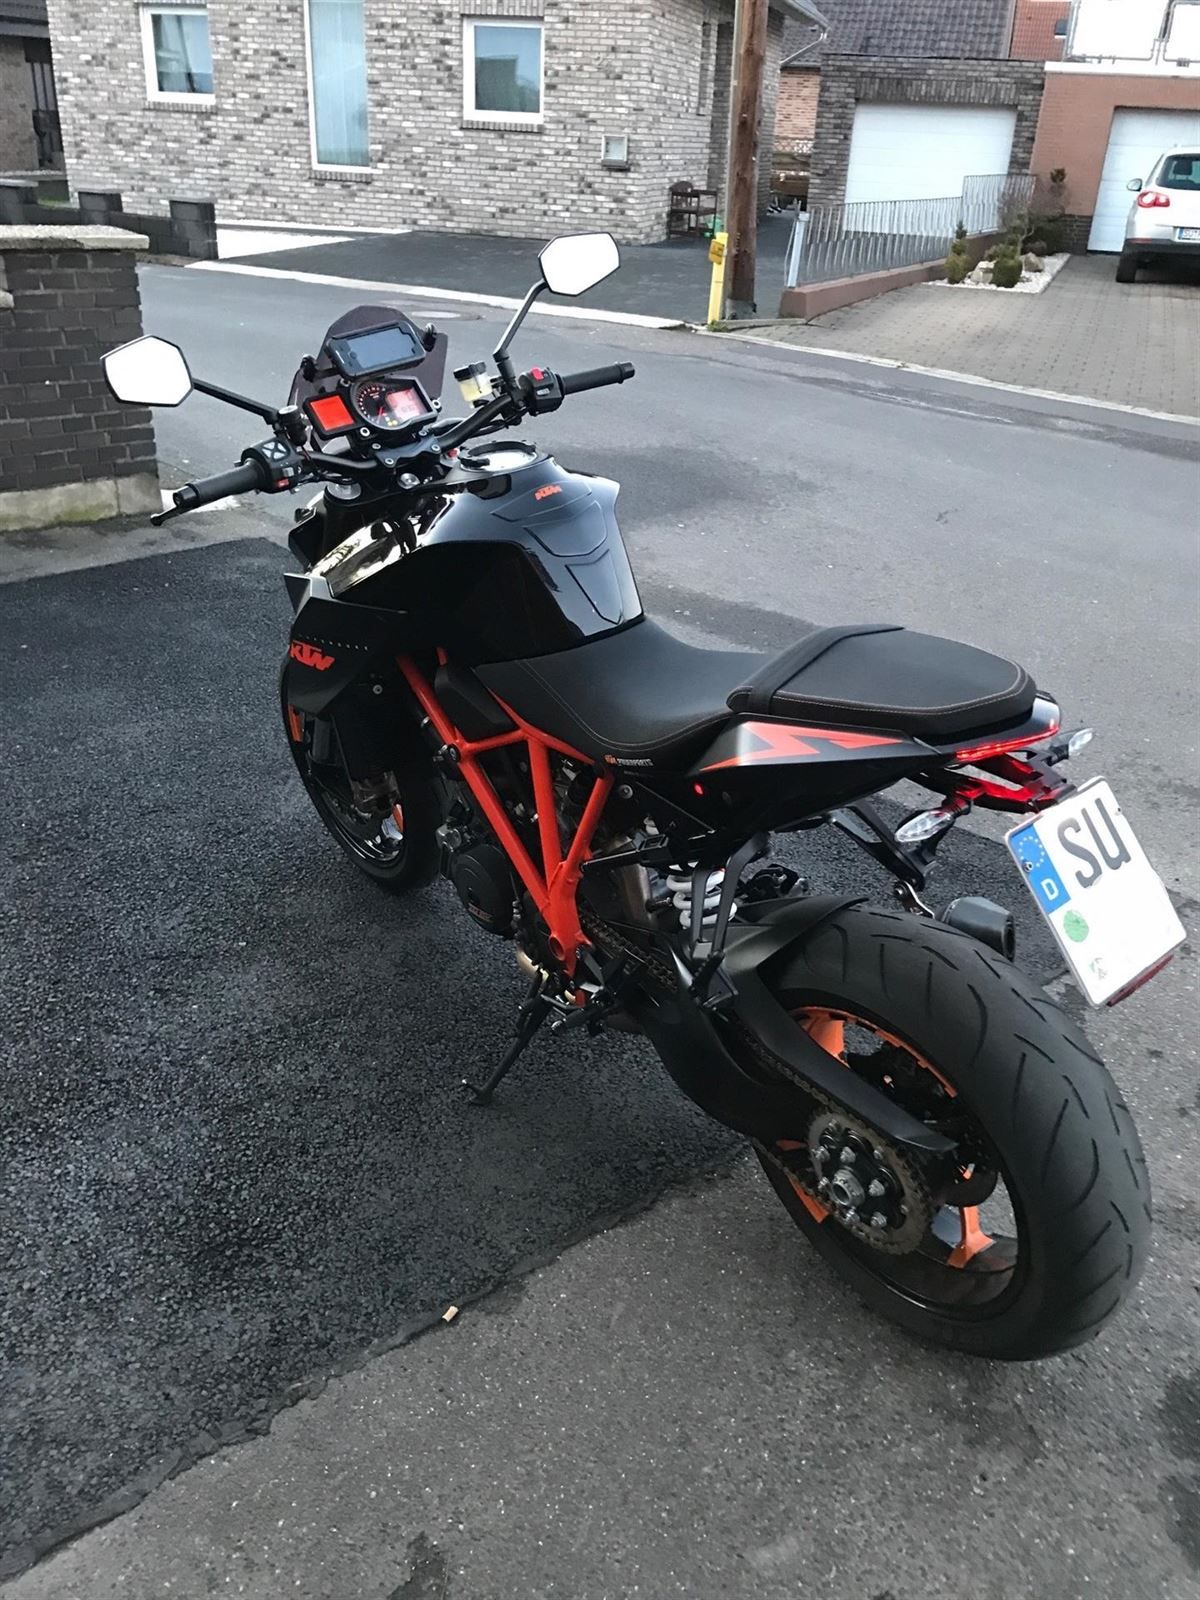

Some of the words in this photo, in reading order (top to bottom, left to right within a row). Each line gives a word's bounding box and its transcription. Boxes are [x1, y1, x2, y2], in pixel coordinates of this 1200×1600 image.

[290, 639, 336, 671] KTM
[1057, 797, 1132, 889] SU
[1040, 877, 1060, 901] D
